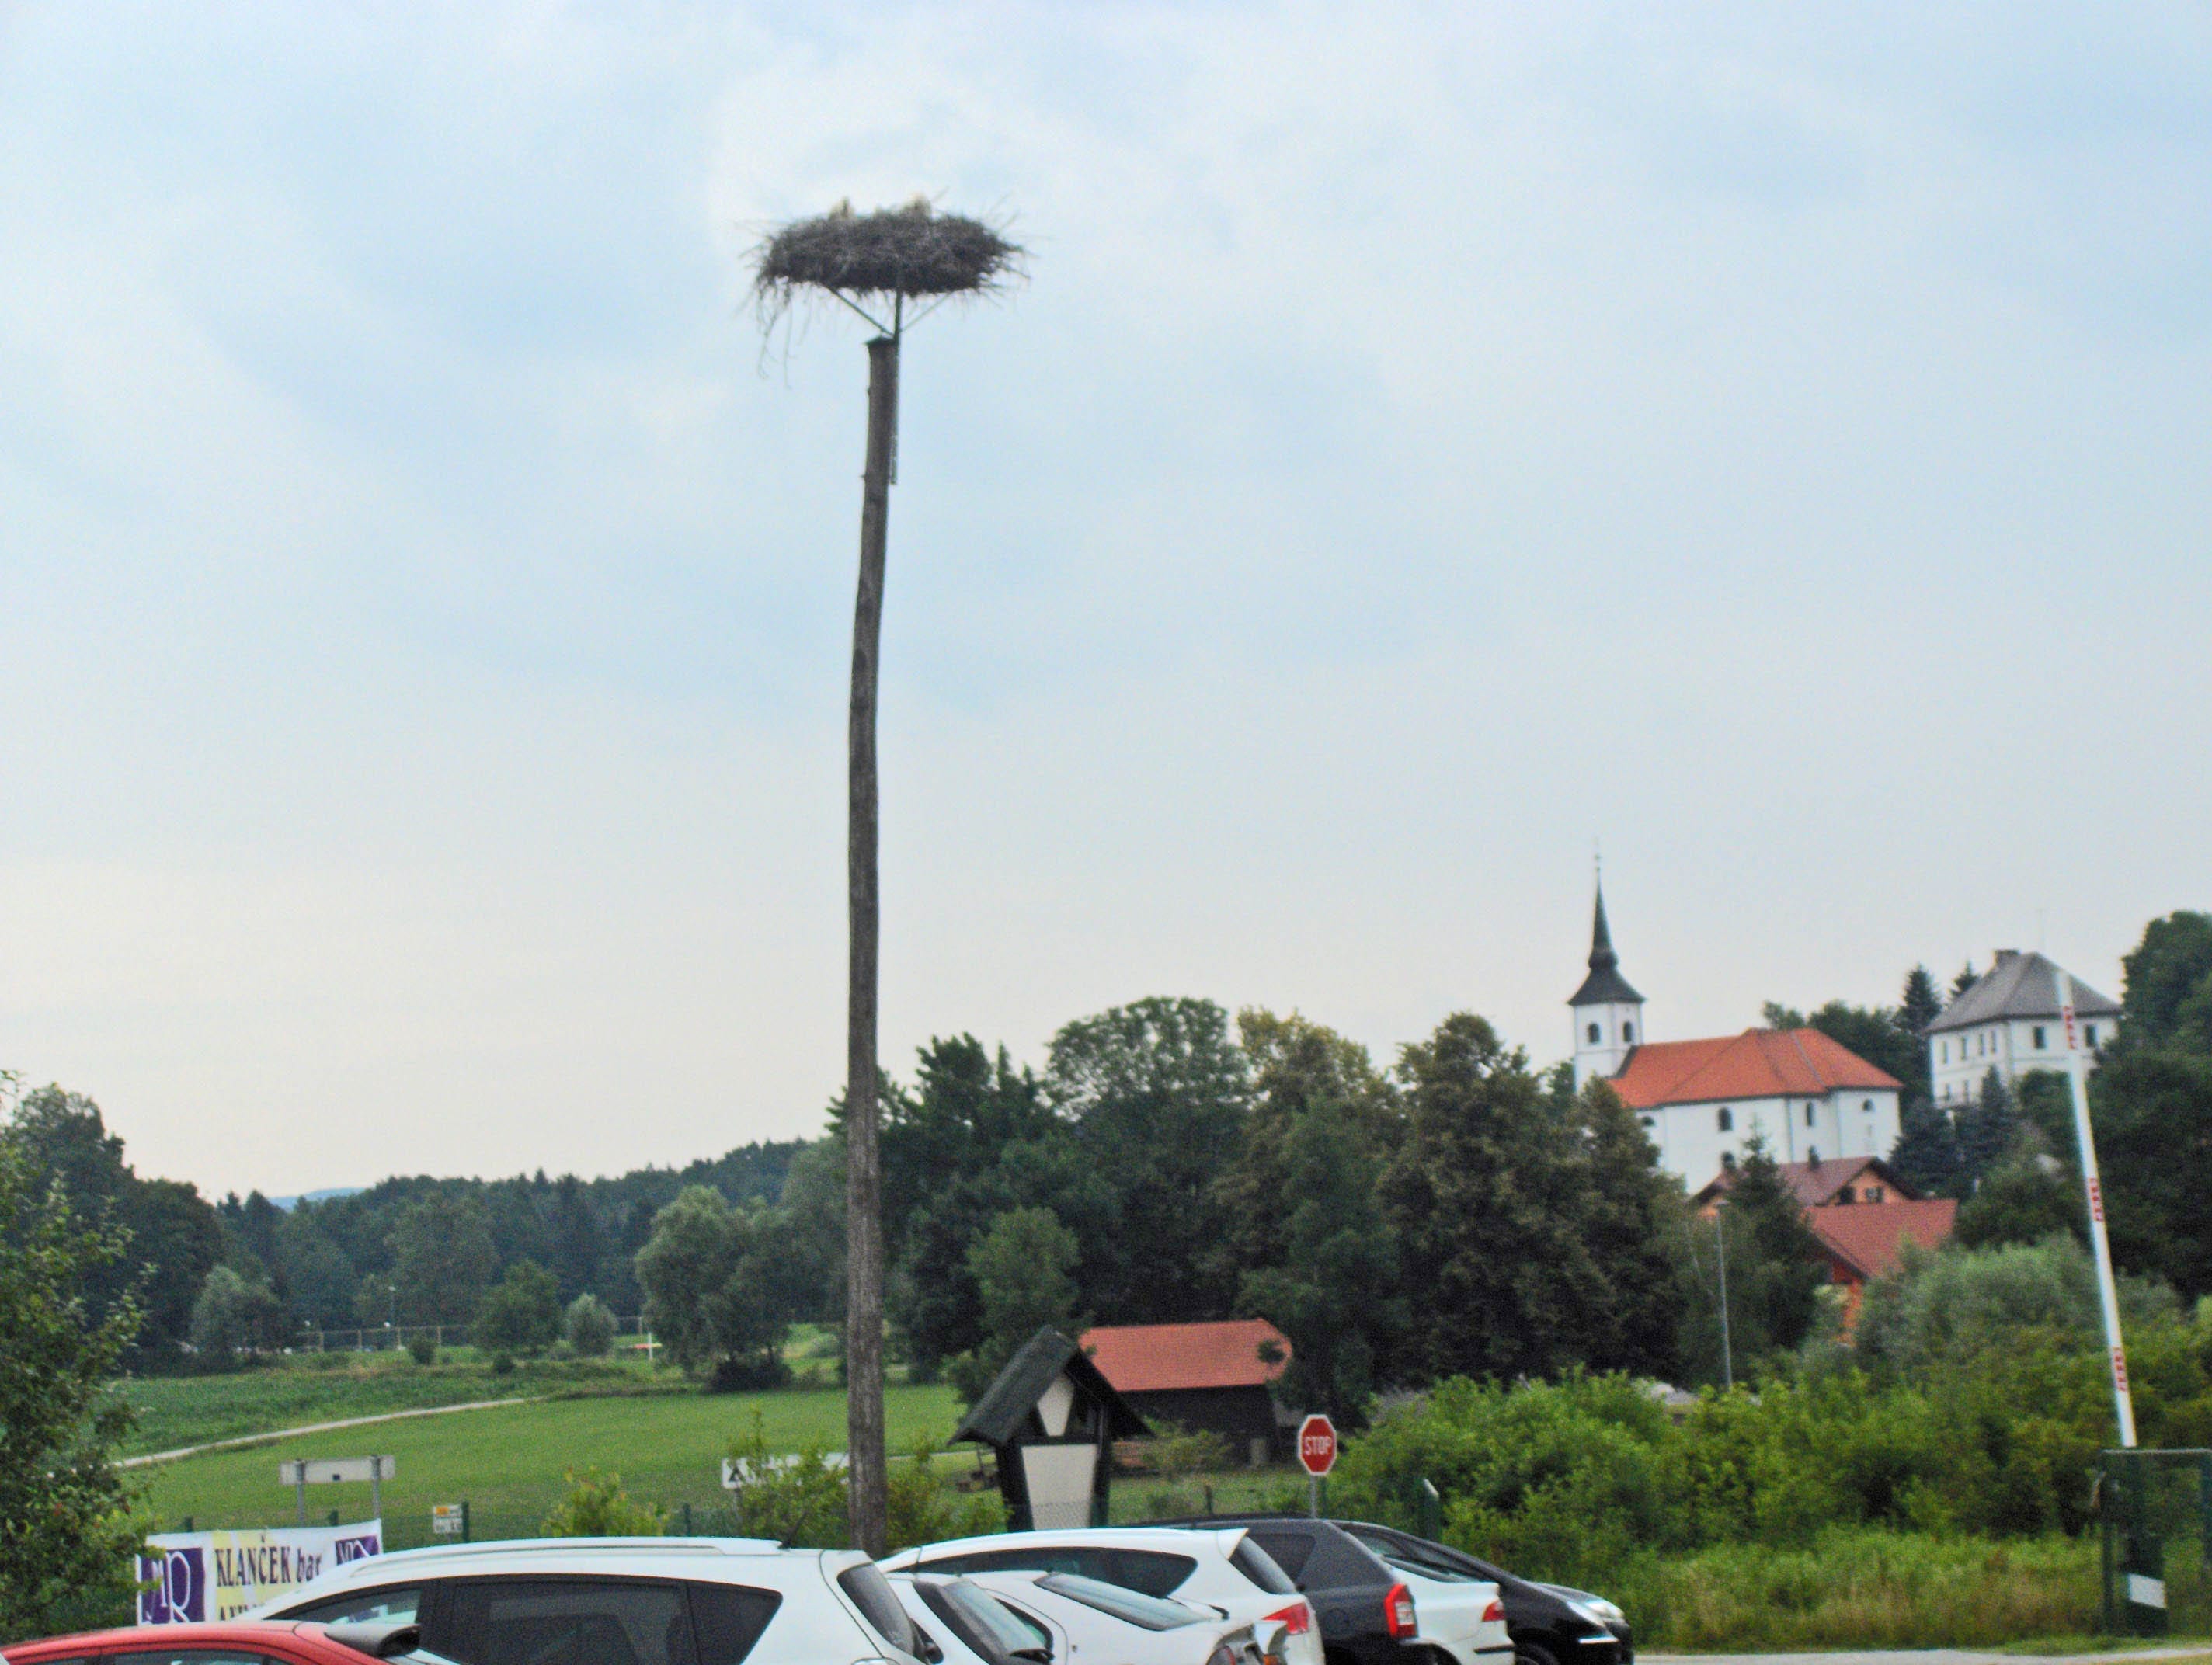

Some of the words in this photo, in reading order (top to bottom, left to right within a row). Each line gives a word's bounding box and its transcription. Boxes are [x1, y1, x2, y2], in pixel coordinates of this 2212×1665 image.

[1304, 1435, 1332, 1455] STOP
[214, 1535, 291, 1587] KLANČEK
[296, 1547, 322, 1583] bar
